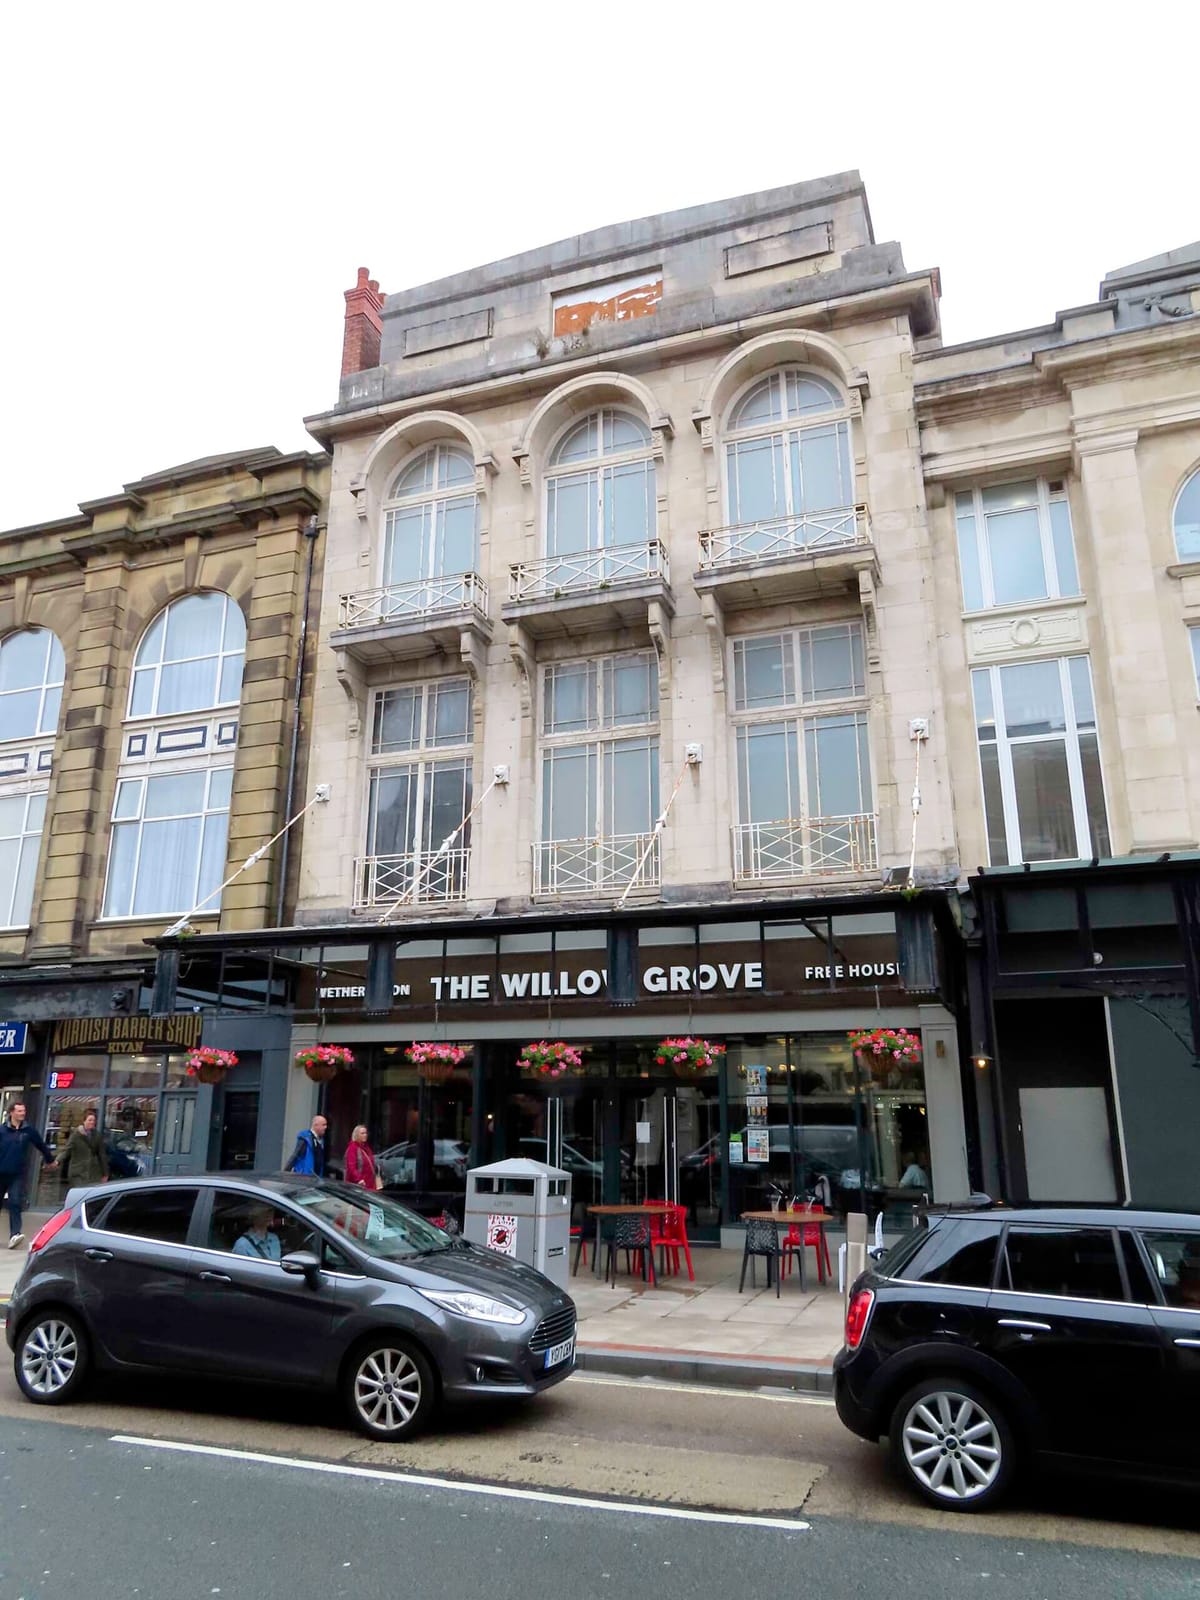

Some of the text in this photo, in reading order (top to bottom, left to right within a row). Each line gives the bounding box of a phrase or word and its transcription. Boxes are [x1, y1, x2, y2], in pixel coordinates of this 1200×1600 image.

[430, 962, 763, 1000] THE WILLO GROVE
[805, 962, 900, 980] FREE HOUS
[52, 1014, 202, 1053] KURDISH BARBER SHOP
